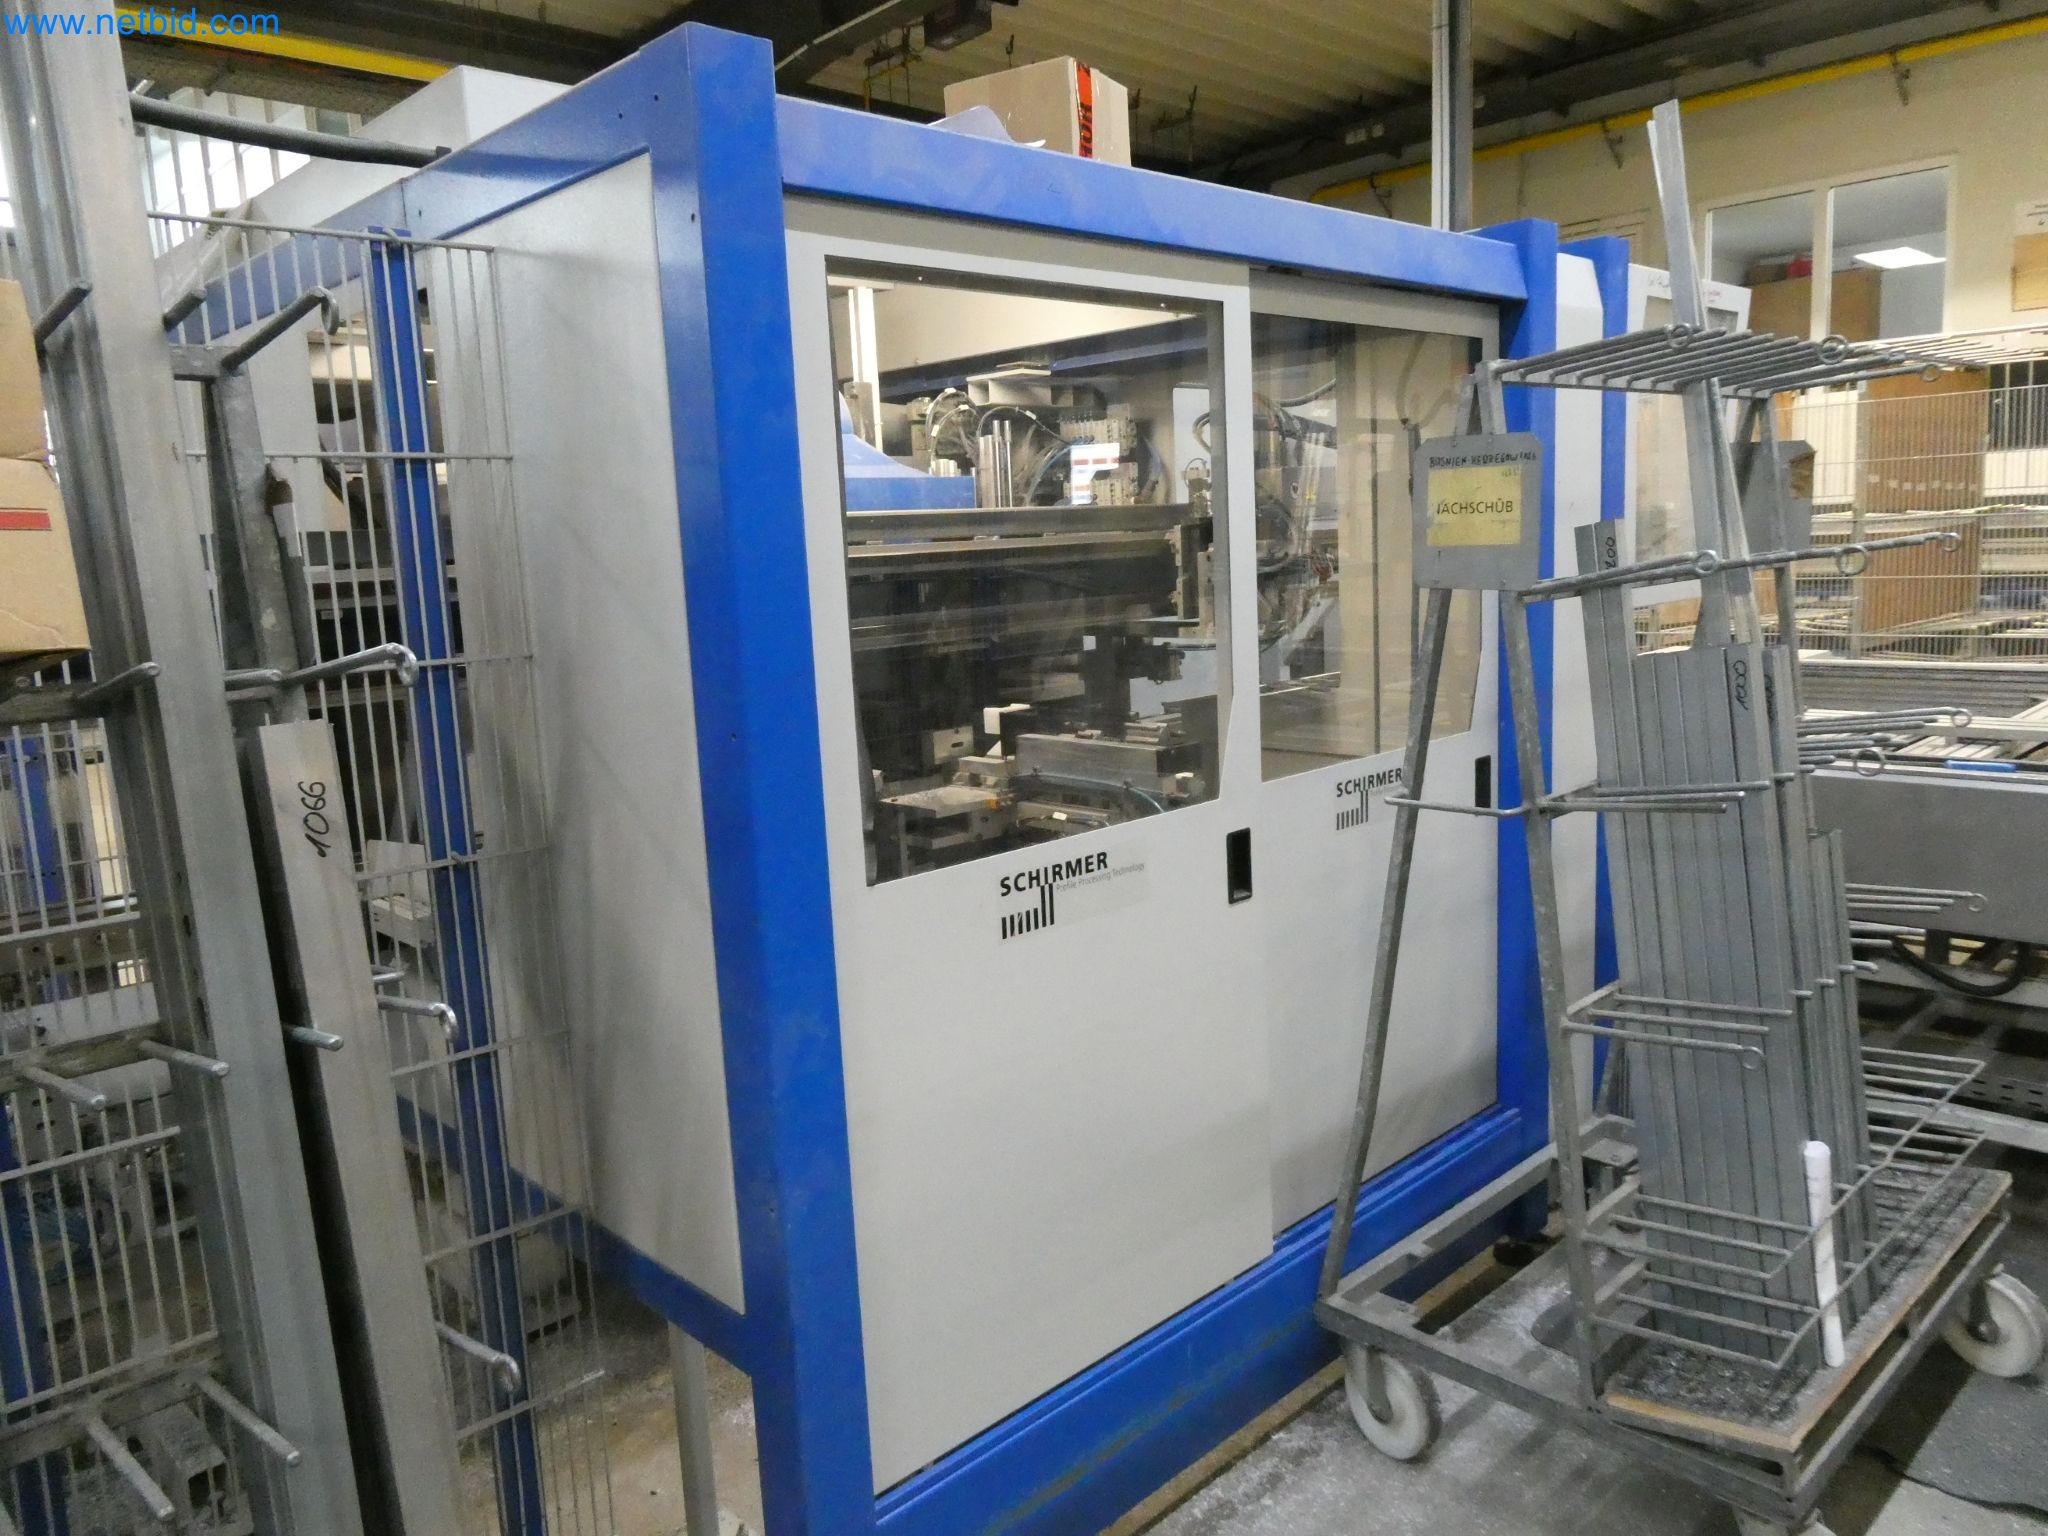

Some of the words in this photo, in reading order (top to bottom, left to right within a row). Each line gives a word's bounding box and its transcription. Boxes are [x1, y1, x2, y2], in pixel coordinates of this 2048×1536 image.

[1336, 768, 1402, 798] SCHIRMER
[298, 781, 331, 858] 1066
[1000, 851, 1108, 897] SCHIRMER
